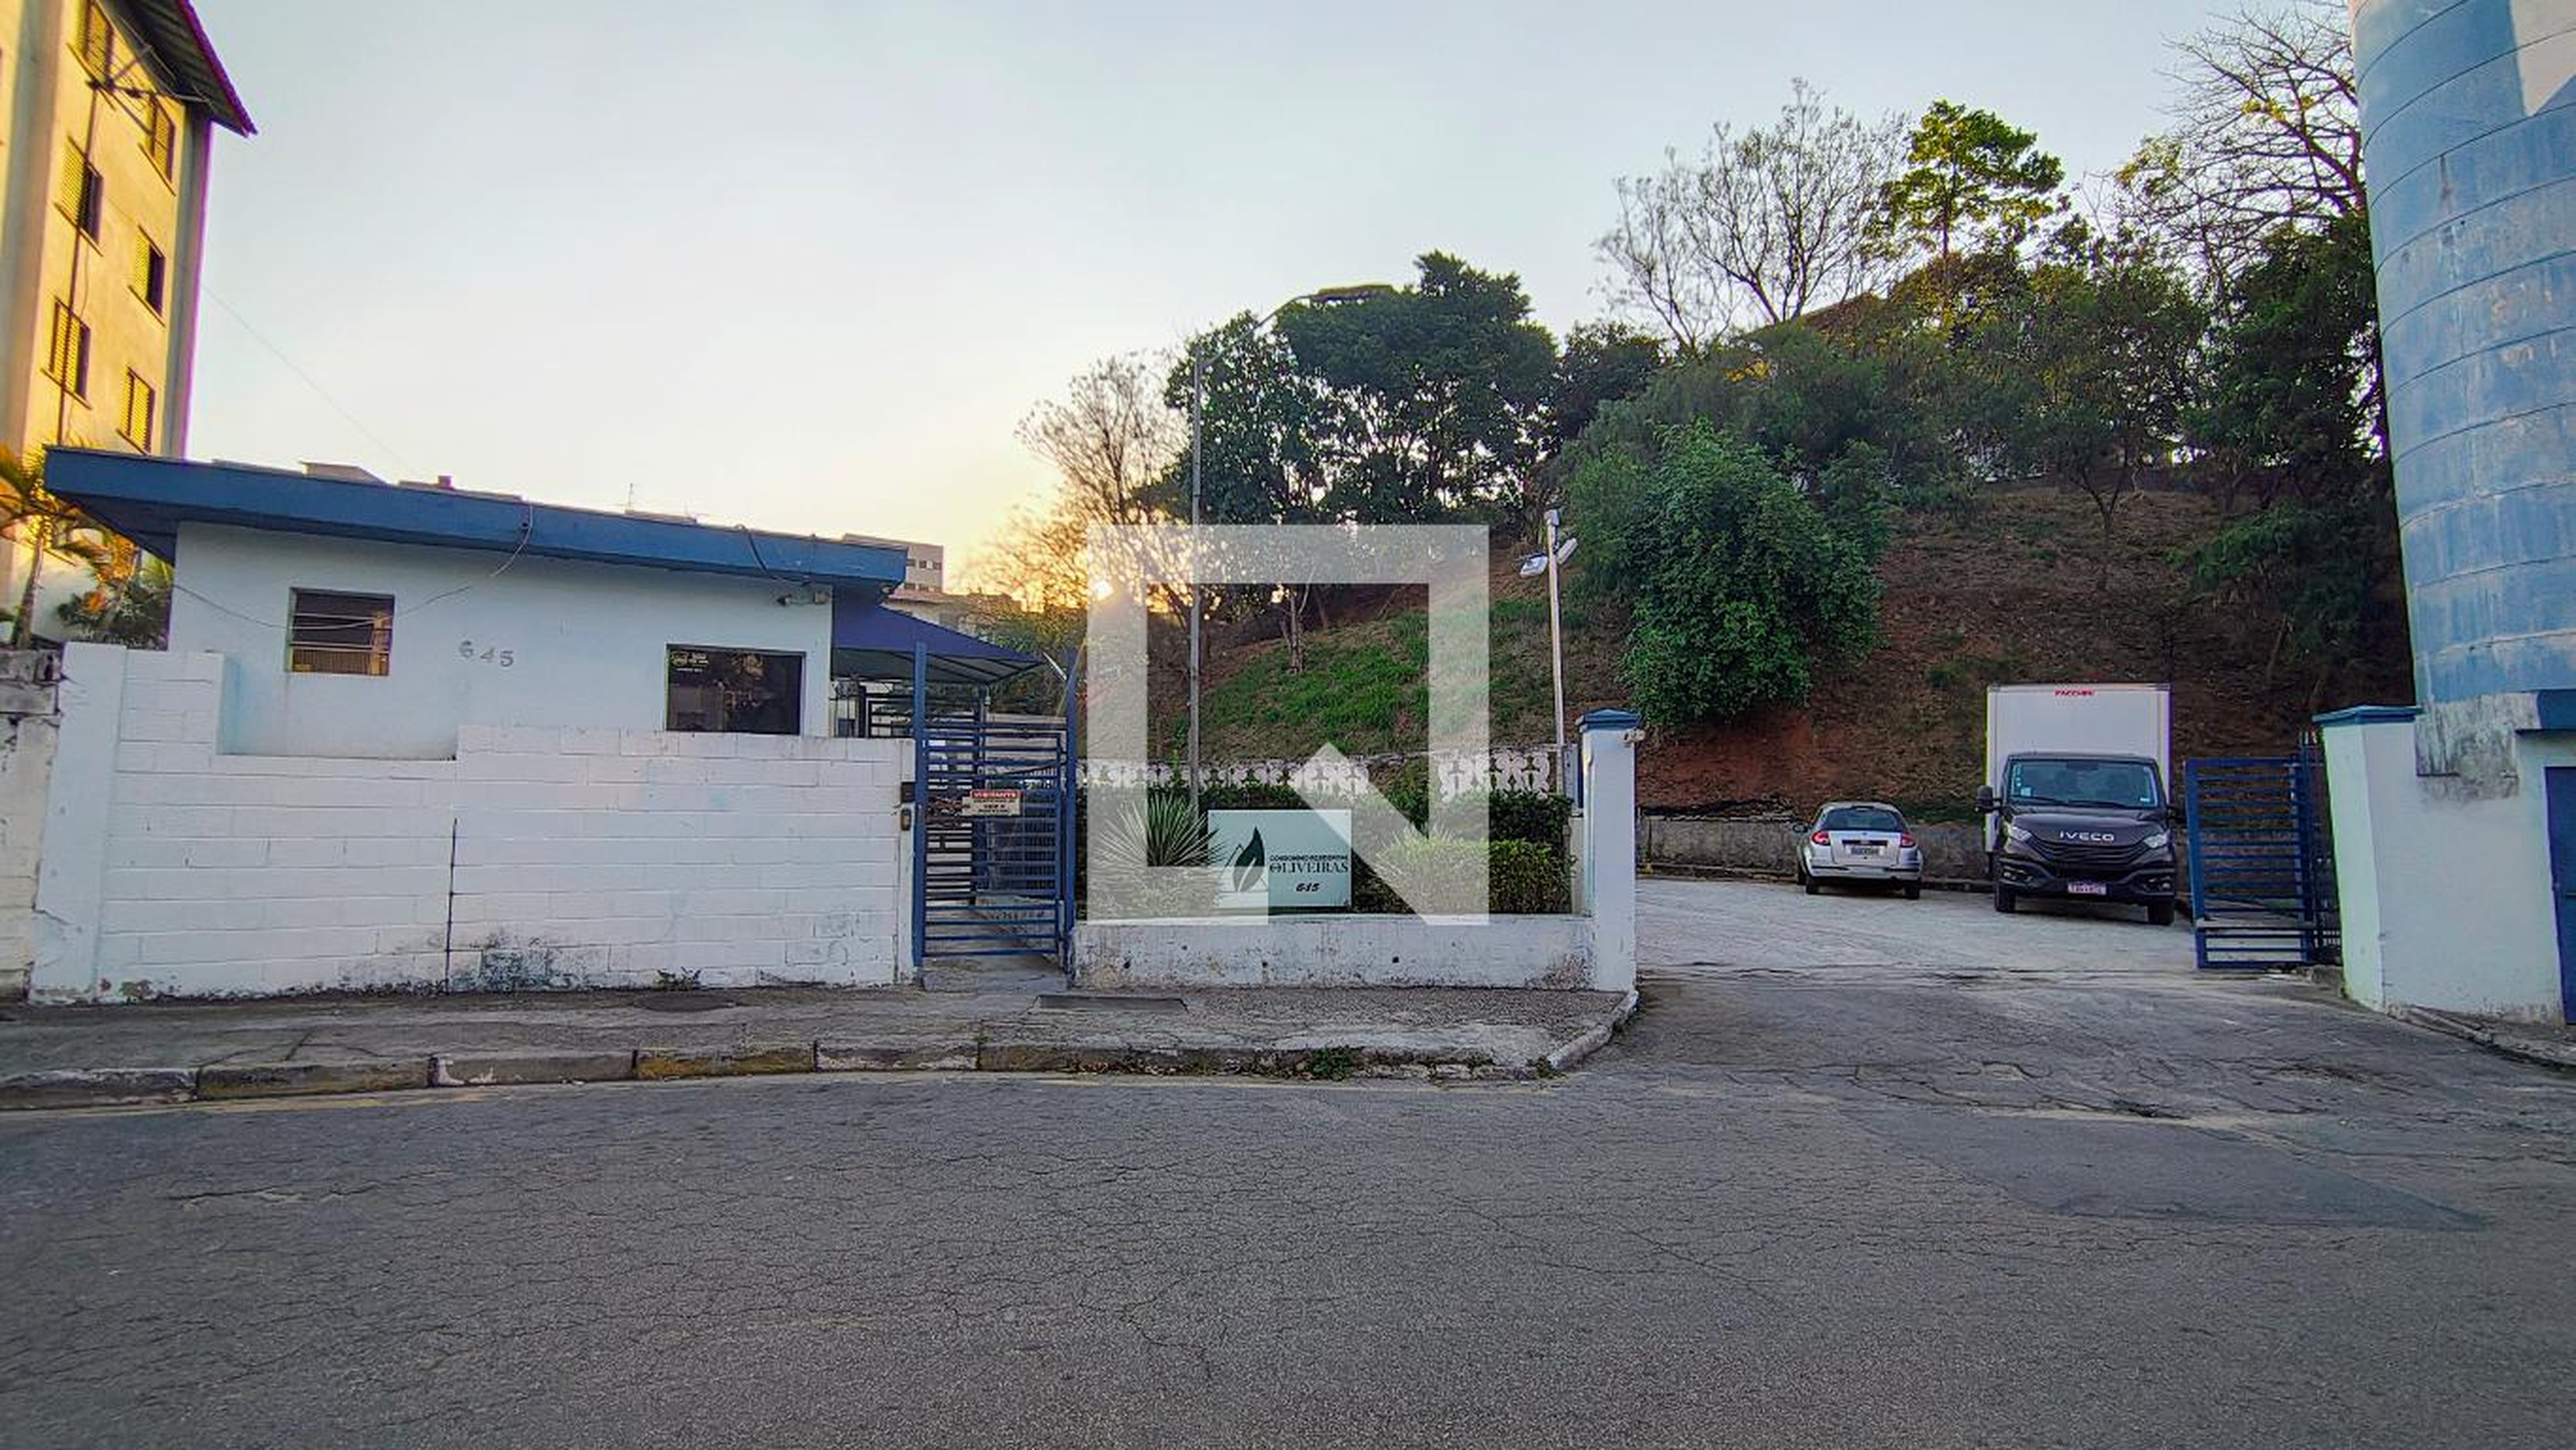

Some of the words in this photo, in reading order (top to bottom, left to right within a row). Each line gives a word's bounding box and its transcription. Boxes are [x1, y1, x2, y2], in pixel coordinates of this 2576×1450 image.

[458, 640, 514, 667] 645
[2059, 831, 2115, 841] IVECO
[1269, 862, 1348, 873] OLIVEIRAS
